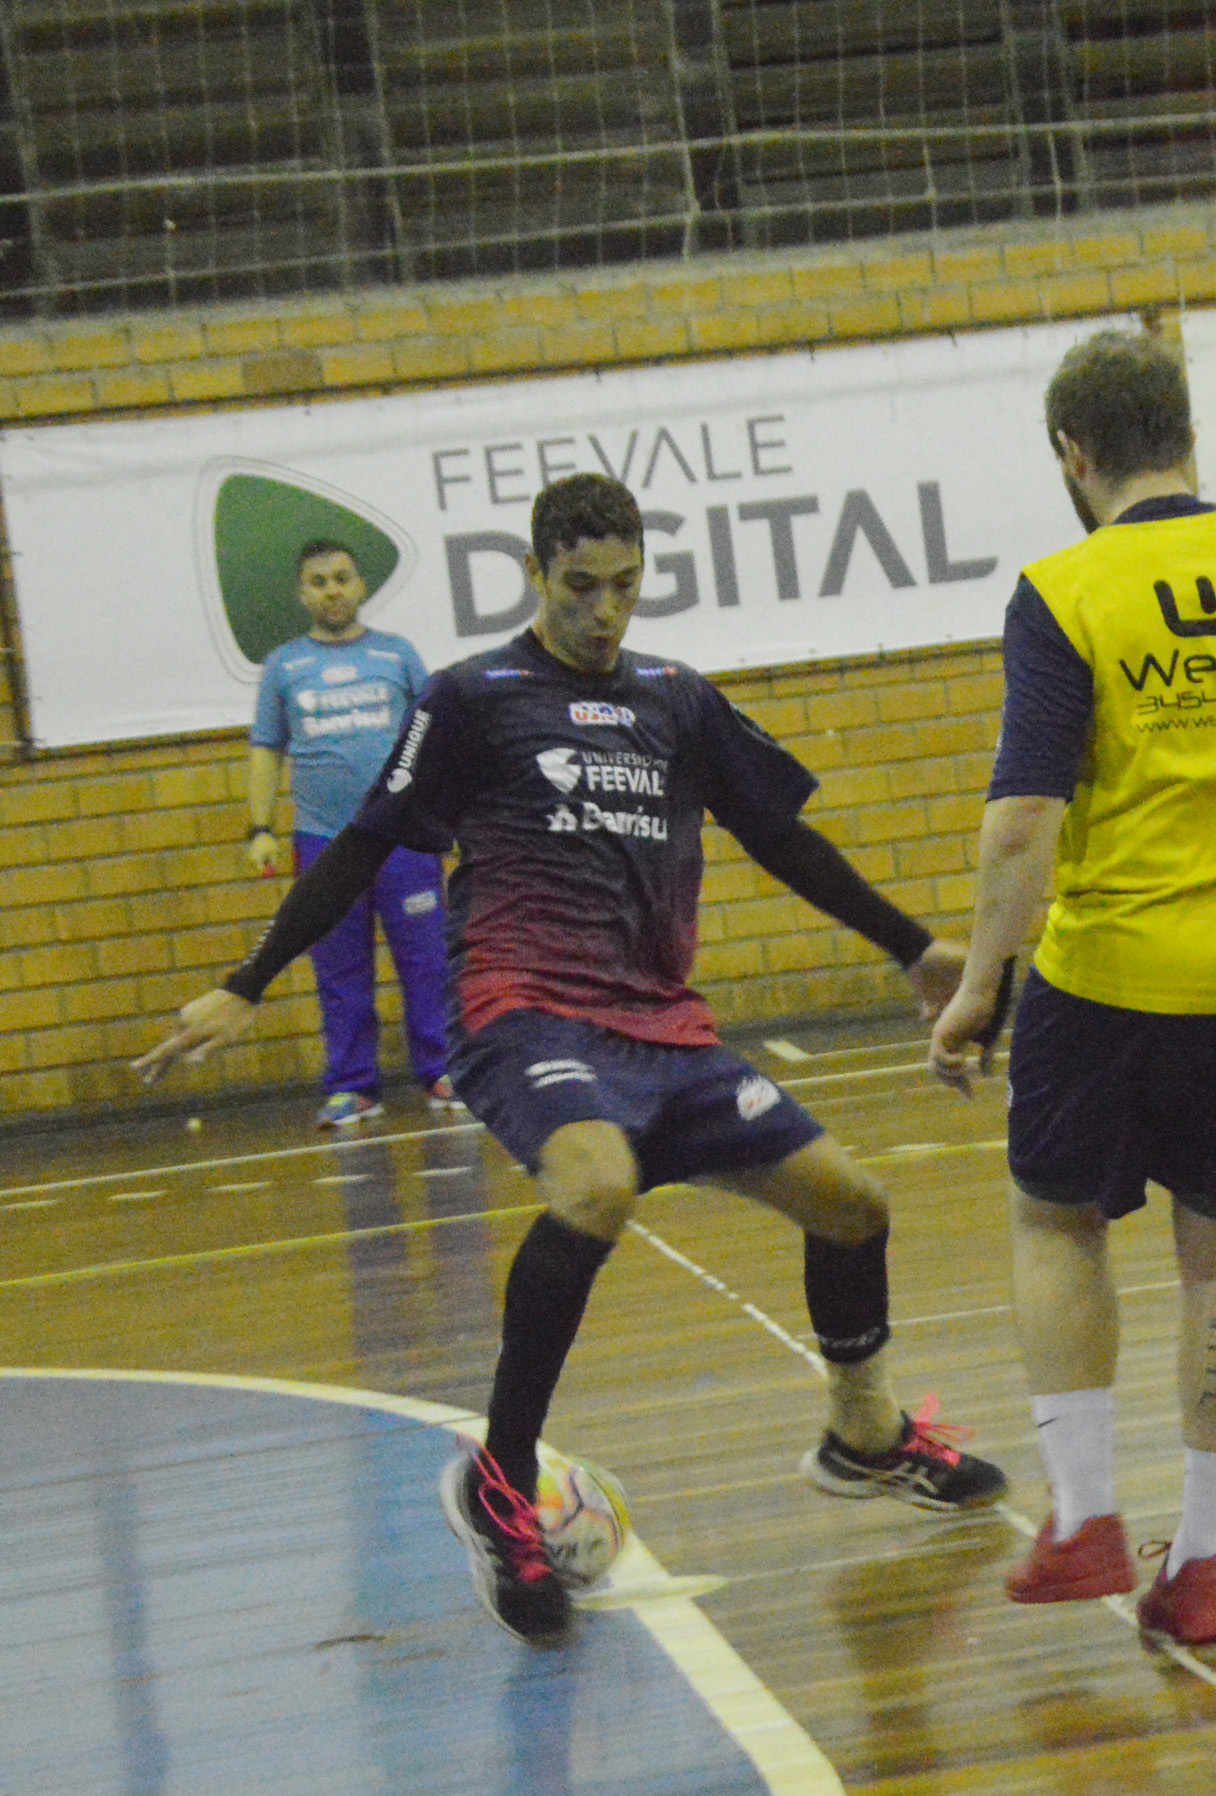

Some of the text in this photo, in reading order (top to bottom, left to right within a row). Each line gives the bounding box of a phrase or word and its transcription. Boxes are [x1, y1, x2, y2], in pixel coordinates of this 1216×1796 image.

[431, 413, 794, 511] FEEVALE
[443, 480, 999, 638] DGITAL
[585, 764, 665, 797] FEEVAL
